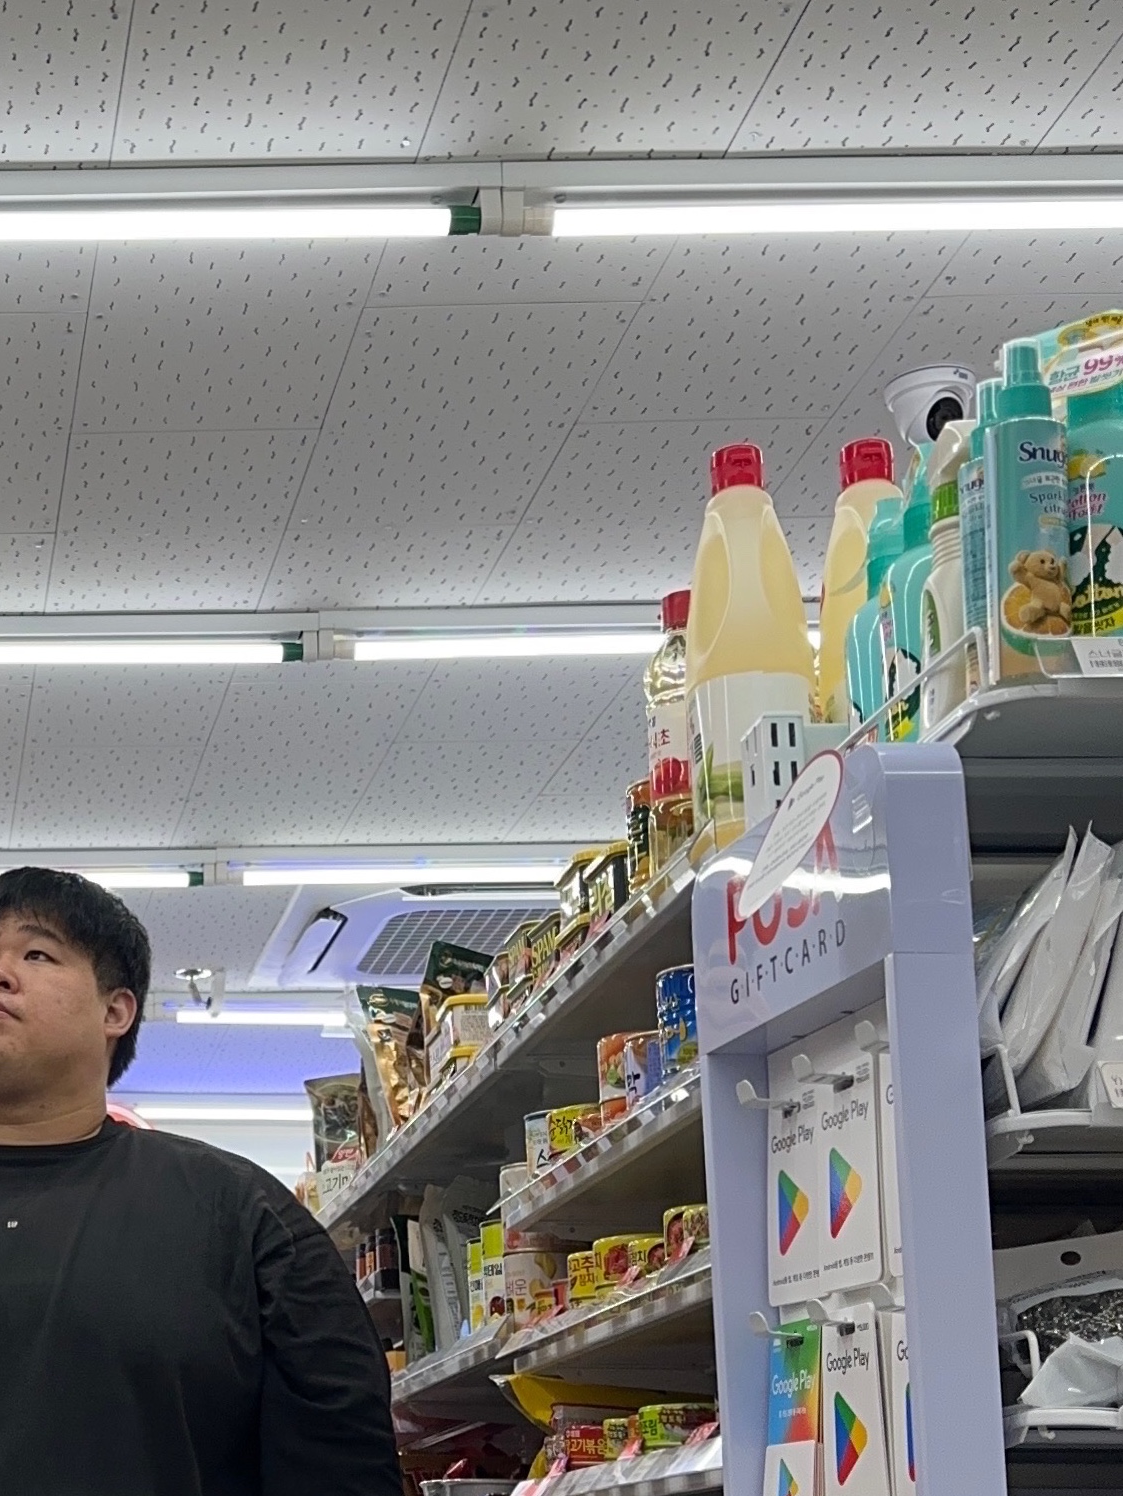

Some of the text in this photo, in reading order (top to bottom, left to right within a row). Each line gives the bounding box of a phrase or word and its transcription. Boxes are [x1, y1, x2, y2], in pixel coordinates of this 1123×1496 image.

[1019, 441, 1068, 469] Snug
[821, 1101, 869, 1131] Google Play
[771, 1124, 814, 1154] Google Play
[827, 1348, 870, 1375] Google Play
[772, 1369, 815, 1398] Google Play
